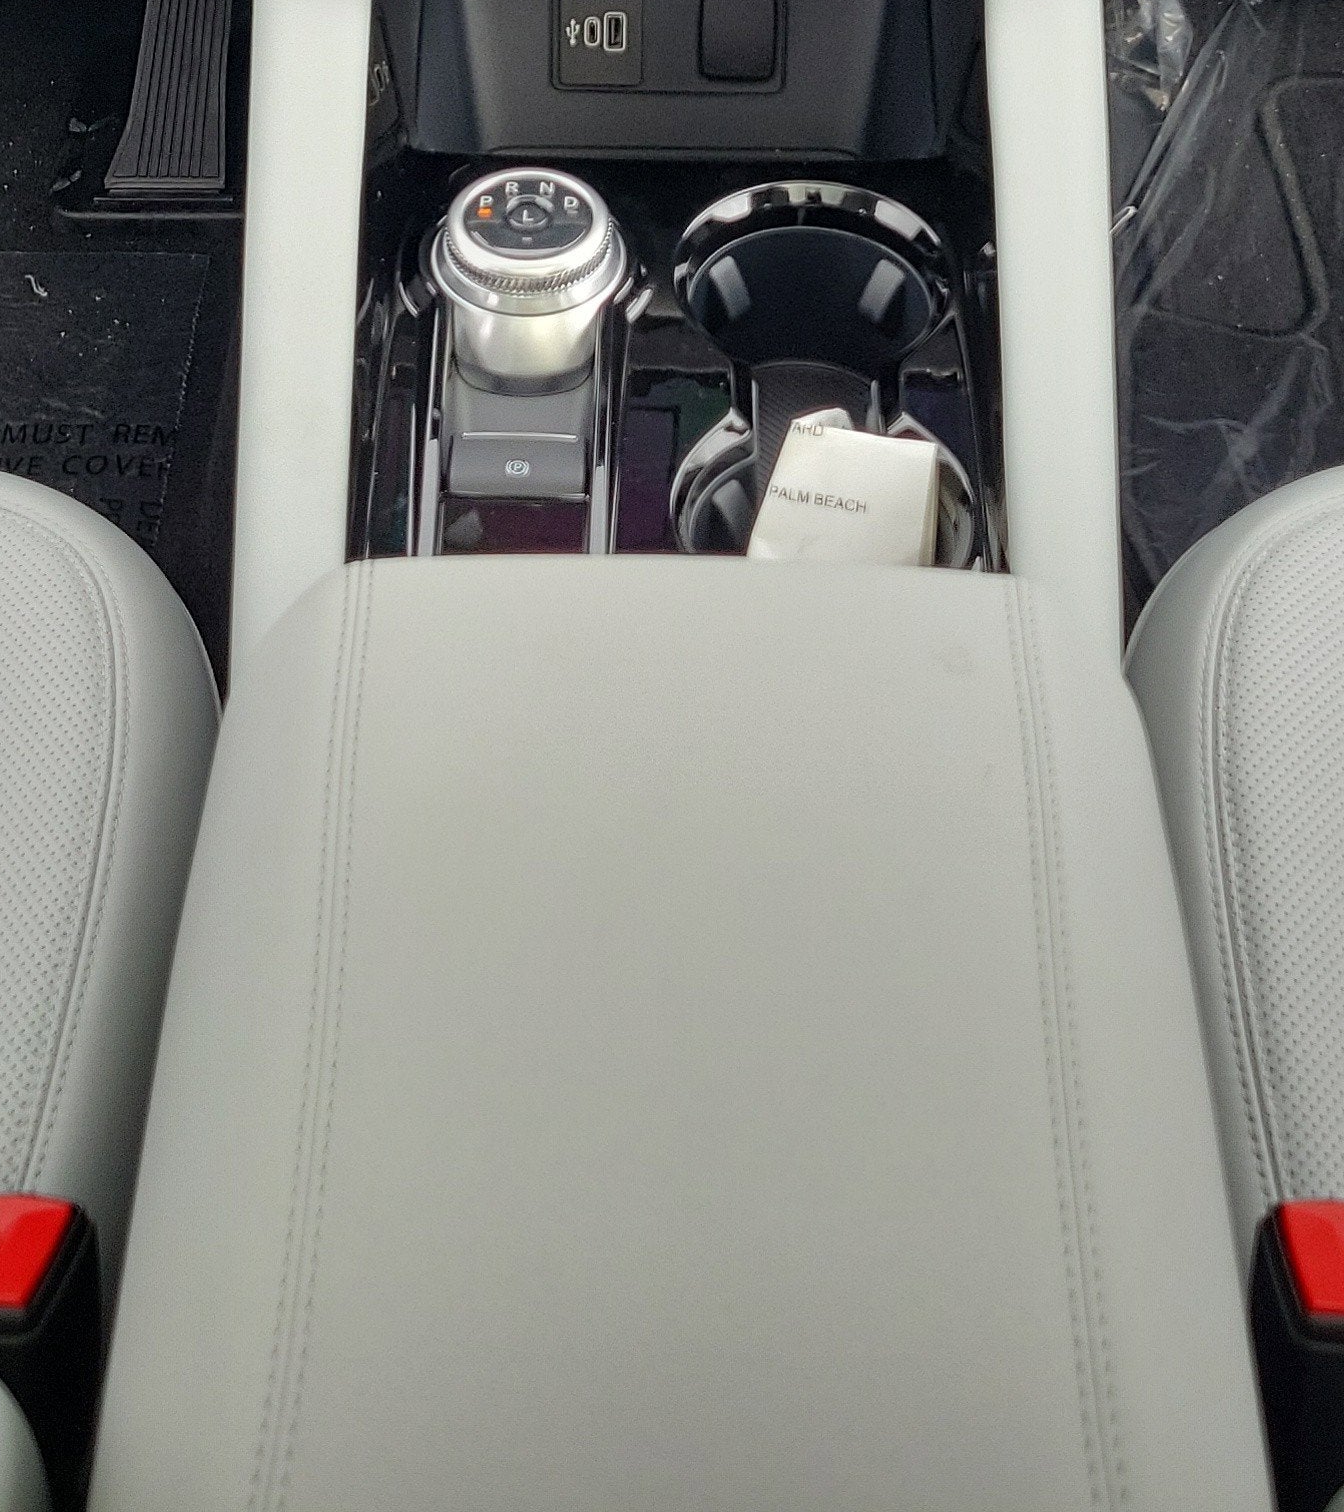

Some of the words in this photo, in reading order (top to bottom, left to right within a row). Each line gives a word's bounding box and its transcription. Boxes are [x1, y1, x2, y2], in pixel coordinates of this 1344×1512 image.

[479, 194, 494, 208] P
[504, 180, 520, 199] R
[538, 180, 555, 198] N
[563, 195, 579, 211] D
[522, 208, 535, 225] L
[0, 423, 96, 447] MUST
[769, 485, 810, 504] PALM
[813, 493, 868, 513] BEACH
